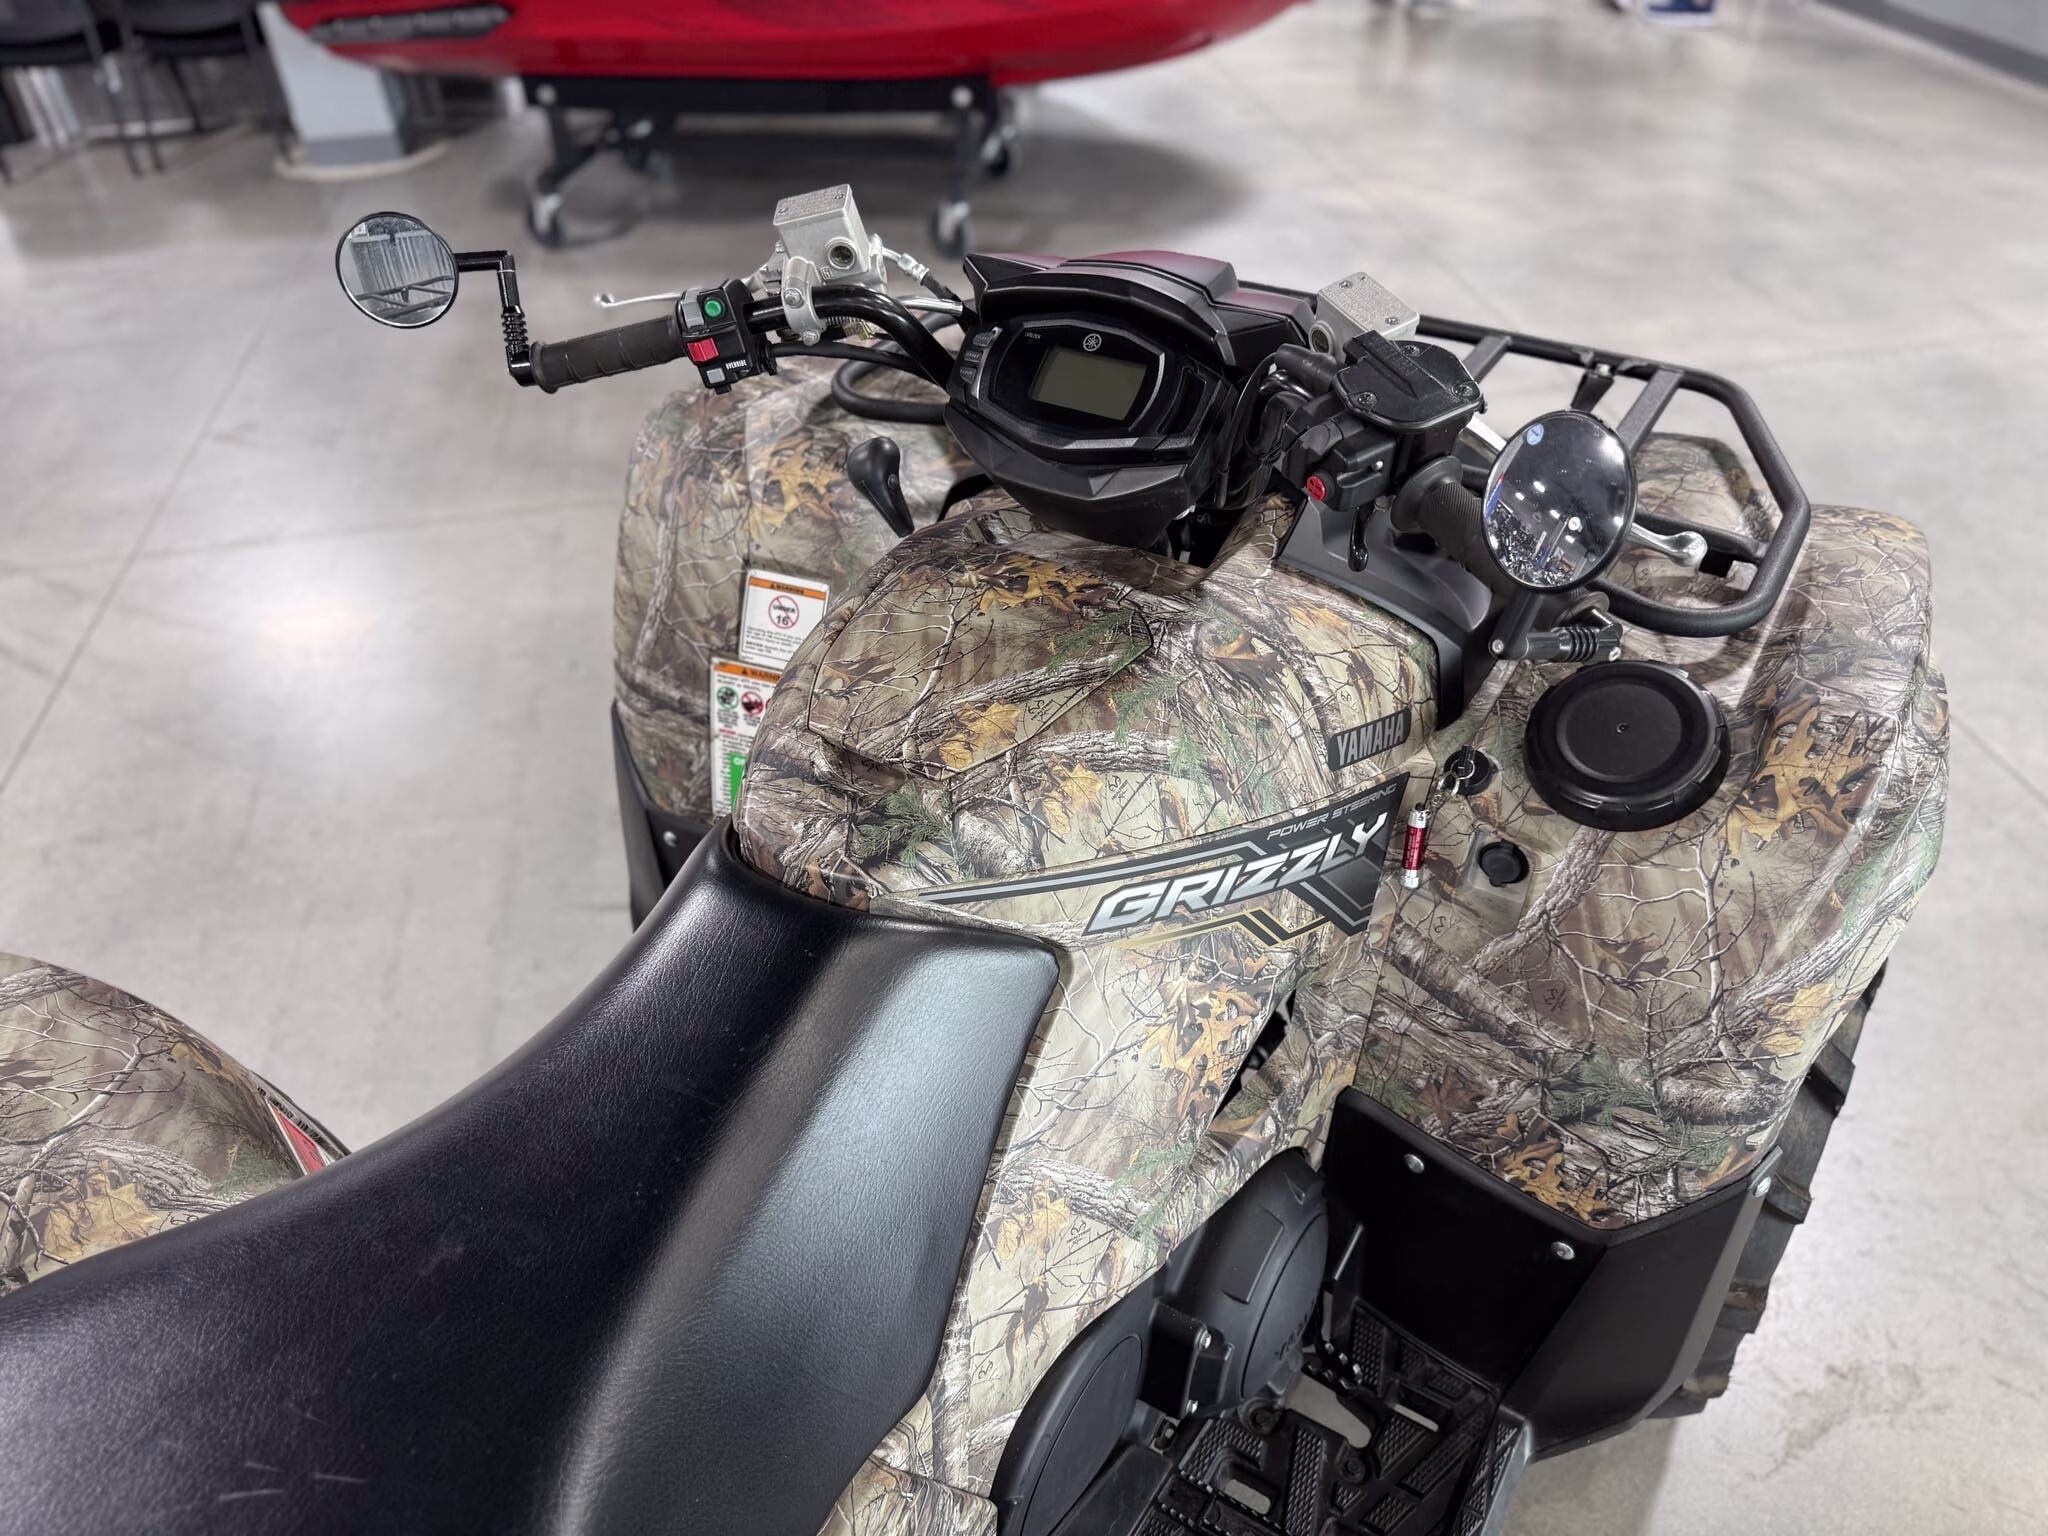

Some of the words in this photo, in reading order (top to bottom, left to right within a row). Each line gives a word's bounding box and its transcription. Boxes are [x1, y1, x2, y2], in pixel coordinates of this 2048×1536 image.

[773, 603, 796, 614] UNDER
[776, 614, 790, 626] 16
[1336, 712, 1404, 766] YAMAHA
[1266, 812, 1330, 840] POWER
[1331, 783, 1397, 820] STEERING
[1085, 811, 1388, 934] GRIZZLY
